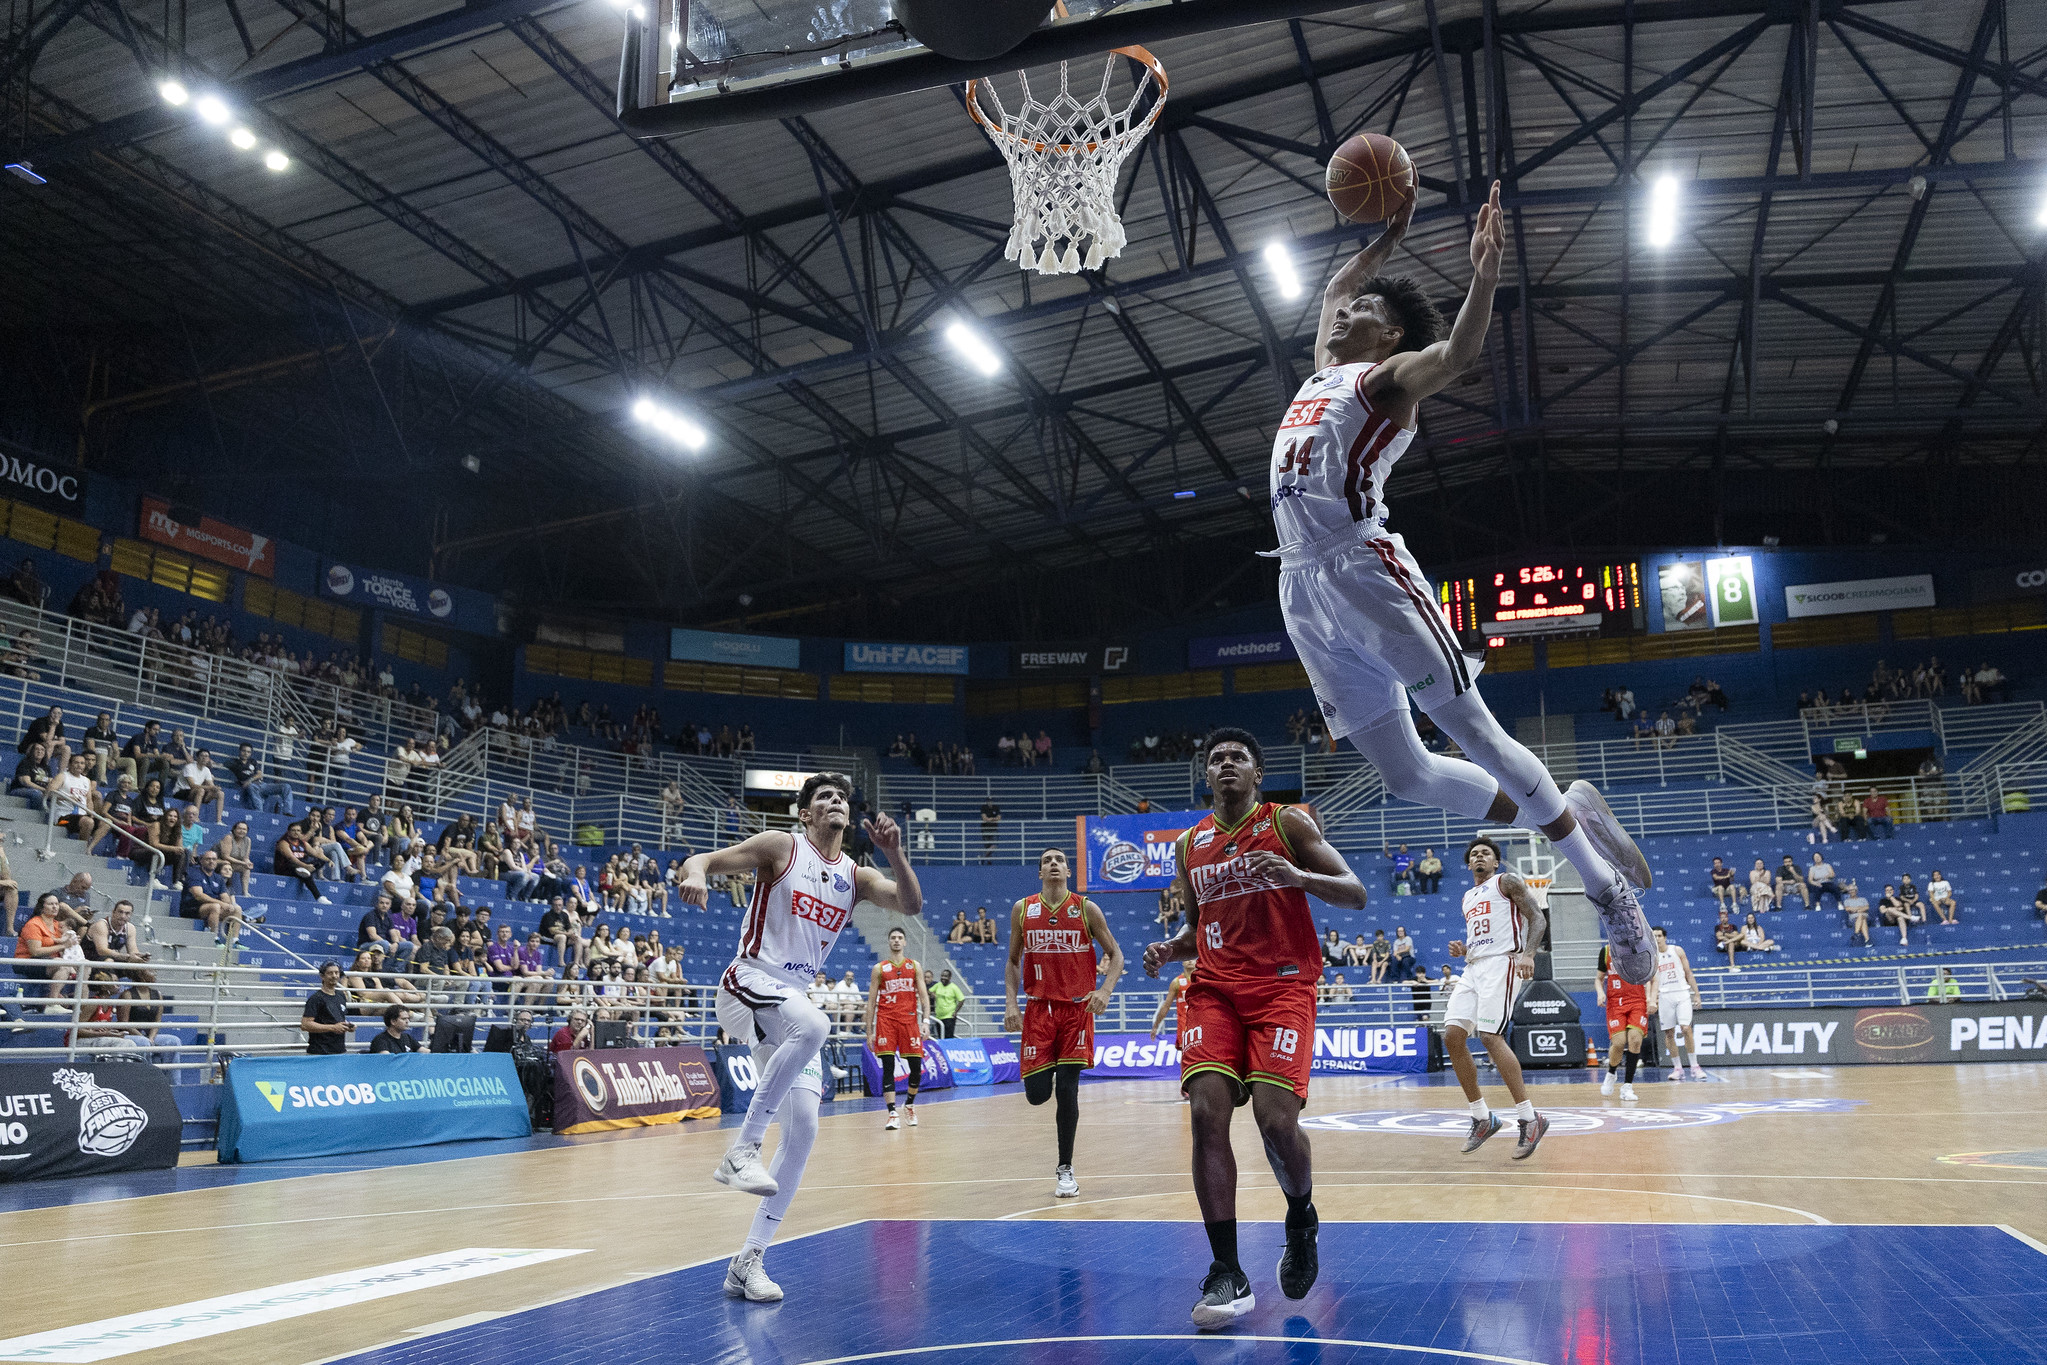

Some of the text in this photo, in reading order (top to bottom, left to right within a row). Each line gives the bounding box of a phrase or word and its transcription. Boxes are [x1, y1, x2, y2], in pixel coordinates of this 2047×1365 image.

[1278, 436, 1315, 476] 34
[1494, 573, 1505, 587] 2
[2016, 568, 2047, 588] CO
[1723, 577, 1742, 603] 8
[1021, 652, 1088, 665] FREEWAY
[796, 896, 840, 930] SESI
[1205, 921, 1224, 951] 18
[1473, 918, 1491, 937] 29
[885, 995, 897, 1004] 34
[1523, 1000, 1567, 1009] INGRESSOS
[910, 1036, 921, 1047] 34
[1273, 1027, 1299, 1055] 18
[1313, 1027, 1418, 1059] NIUBE
[1536, 1035, 1557, 1047] Q2
[1322, 1059, 1368, 1071] FRANCA
[91, 1096, 114, 1112] SESI
[86, 1105, 140, 1136] FRANCA
